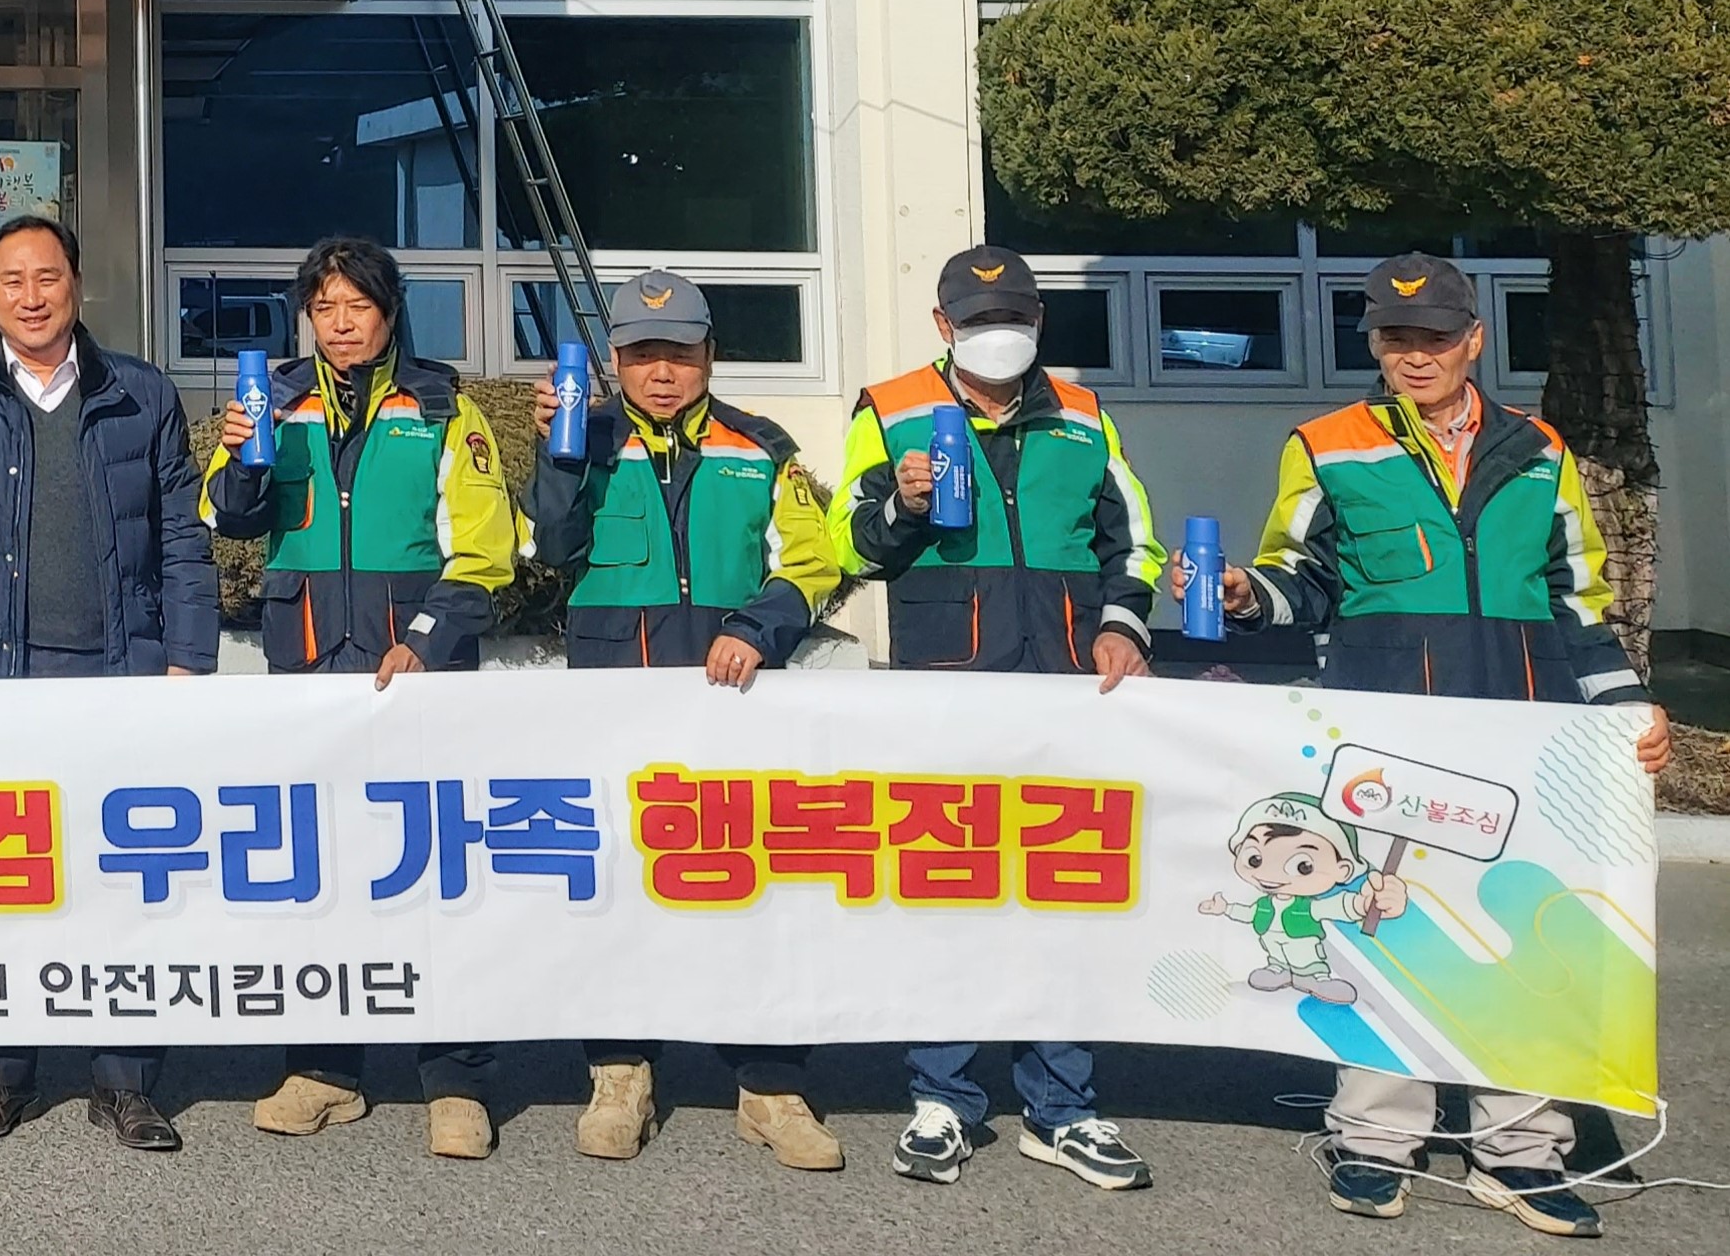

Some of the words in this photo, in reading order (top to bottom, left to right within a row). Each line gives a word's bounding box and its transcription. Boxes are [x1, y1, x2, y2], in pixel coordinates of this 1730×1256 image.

[98, 781, 323, 905] 우리
[366, 778, 602, 903] 가족
[636, 772, 1139, 905] 행복점검
[1397, 794, 1502, 835] 산불조심
[38, 960, 421, 1018] 안전지킴이단
